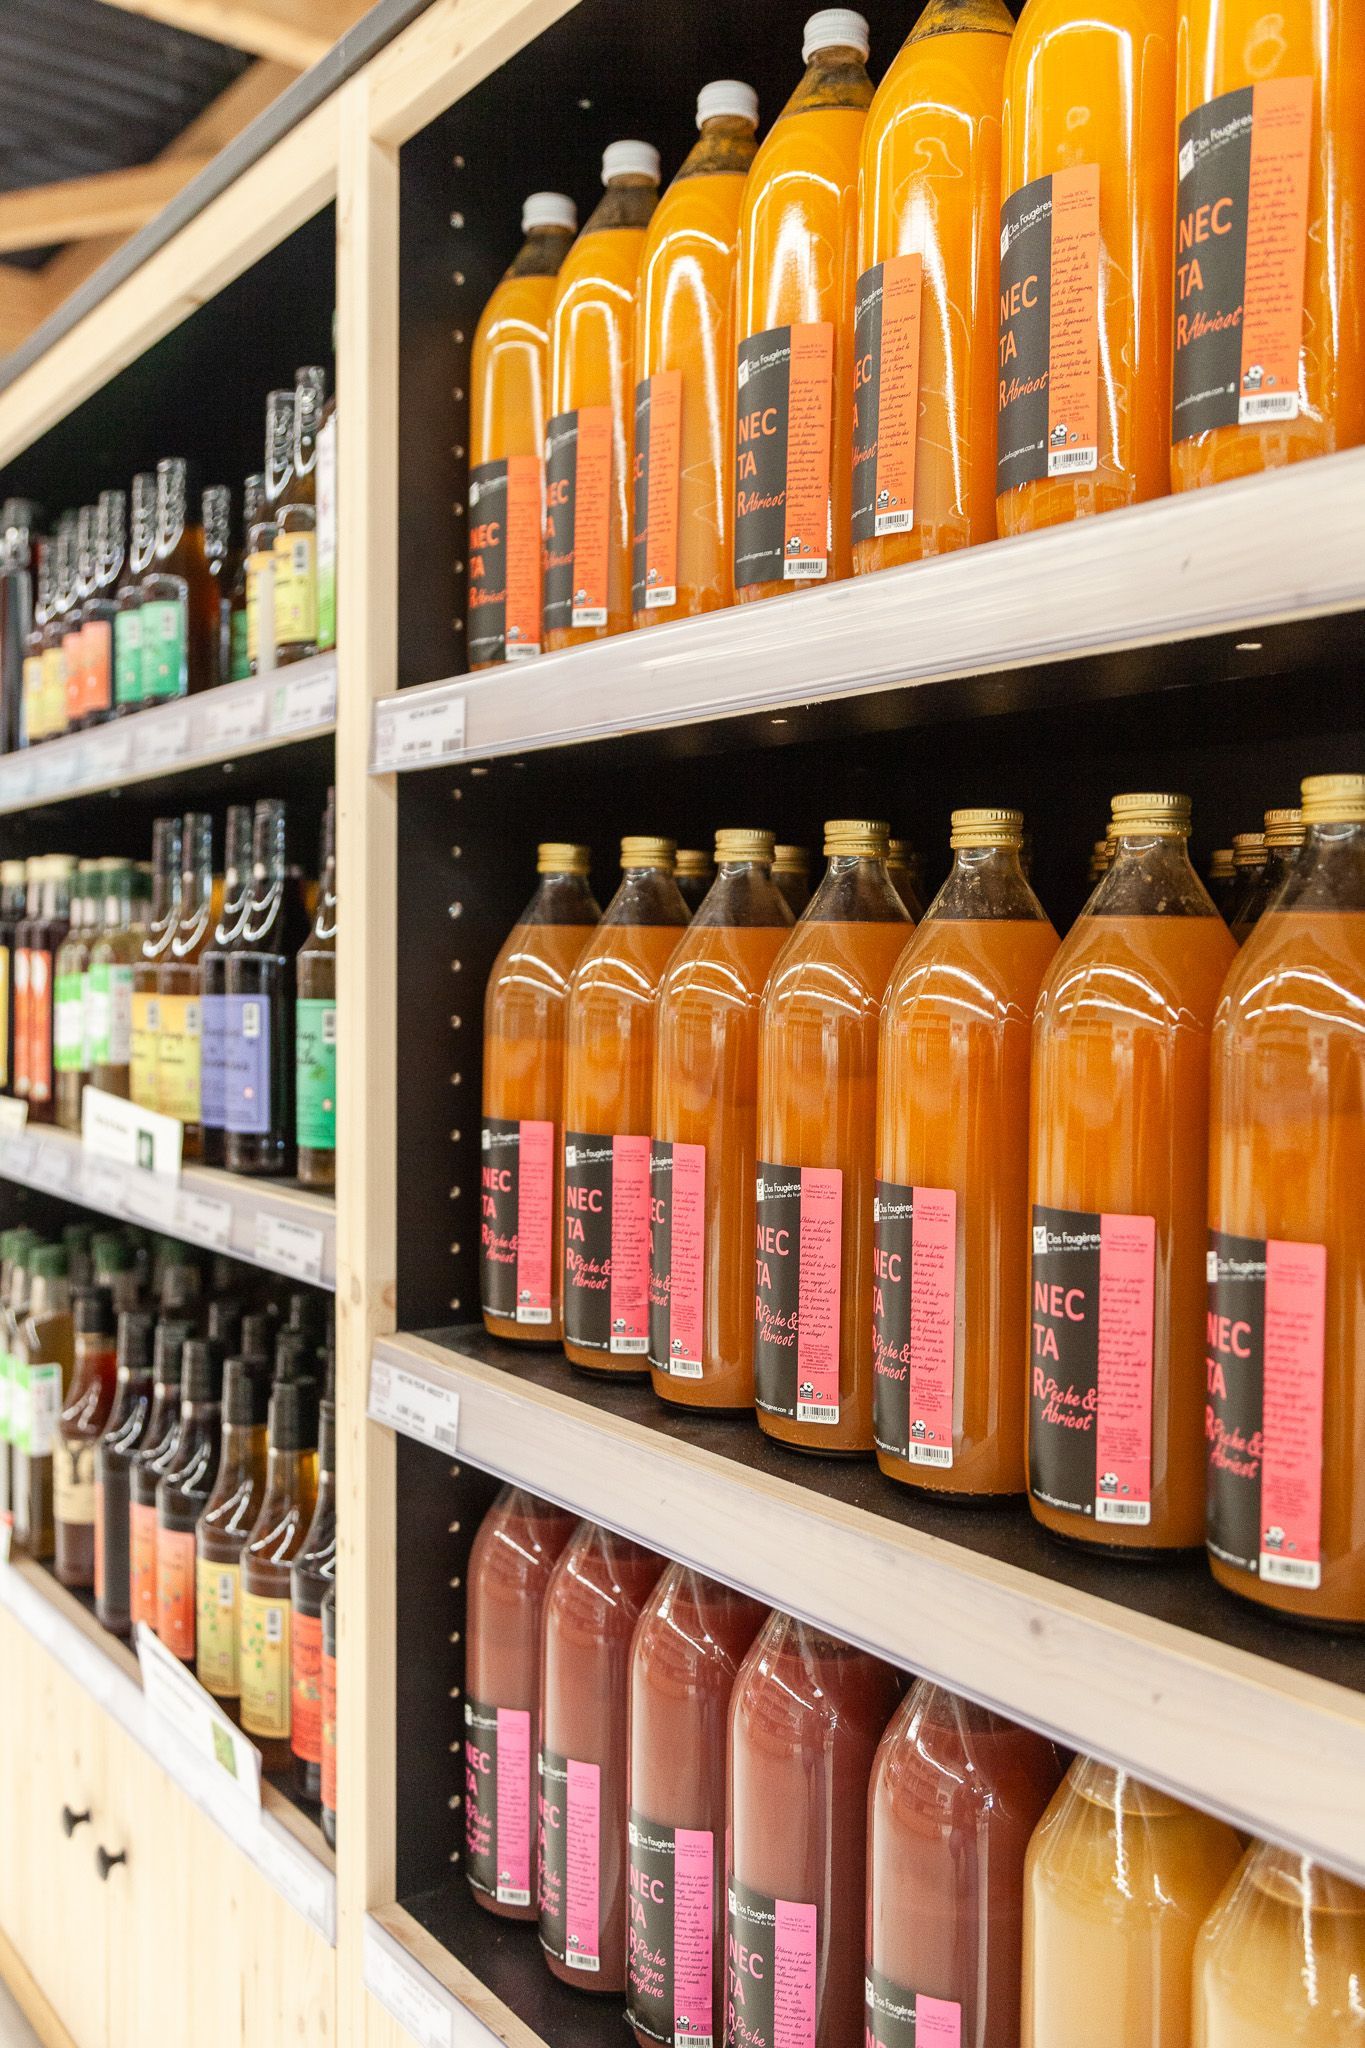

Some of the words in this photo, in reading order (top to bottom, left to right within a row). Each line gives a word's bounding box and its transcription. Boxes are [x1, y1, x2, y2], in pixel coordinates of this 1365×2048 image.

[1210, 114, 1253, 142] Fougères
[1020, 200, 1052, 226] Fougères
[1179, 197, 1233, 253] NEC
[1177, 258, 1204, 300] TA
[1000, 274, 1038, 326] NEC
[1186, 305, 1243, 341] Abricot
[760, 347, 791, 364] Fougères
[1000, 330, 1018, 368] TA
[1006, 370, 1049, 401] Abricot
[738, 408, 778, 445] NEC
[737, 450, 757, 480] TA
[746, 490, 786, 513] Abricot
[482, 1166, 512, 1193] NEC
[774, 1182, 802, 1194] Fougères
[482, 1194, 497, 1220] TA
[566, 1185, 603, 1213] NEC
[888, 1202, 914, 1215] Fougères
[566, 1216, 586, 1242] TA
[756, 1224, 790, 1256] NEC
[1062, 1231, 1101, 1246] Fougères
[574, 1254, 600, 1274] Pêche
[600, 1258, 612, 1276] &
[756, 1259, 772, 1290] TA
[874, 1247, 902, 1282] NEC
[572, 1272, 609, 1290] Abricot
[872, 1285, 885, 1318] TA
[1034, 1280, 1085, 1322] NEC
[761, 1304, 786, 1328] Pêche
[787, 1312, 800, 1331] &
[760, 1322, 796, 1347] Abricot
[876, 1334, 898, 1360] Pêche
[900, 1343, 910, 1364] &
[1033, 1322, 1060, 1361] TA
[1206, 1312, 1251, 1358] NEC
[874, 1354, 908, 1382] Abricot
[1206, 1358, 1227, 1400] TA
[1033, 1366, 1045, 1400] R
[1043, 1377, 1080, 1408] Pêche
[1081, 1388, 1098, 1412] &
[1041, 1401, 1094, 1432] Abricot
[648, 1835, 676, 1849] Fougères
[630, 1863, 664, 1904] NEC
[629, 1893, 648, 1929] TA
[747, 1905, 776, 1921] Fougères
[636, 1938, 667, 1967] Pêche
[729, 1933, 764, 1979] NEC
[640, 1964, 665, 1983] vigne
[728, 1965, 746, 2005] TA
[885, 1998, 916, 2018] Fougères
[734, 2015, 766, 2047] Pêche
